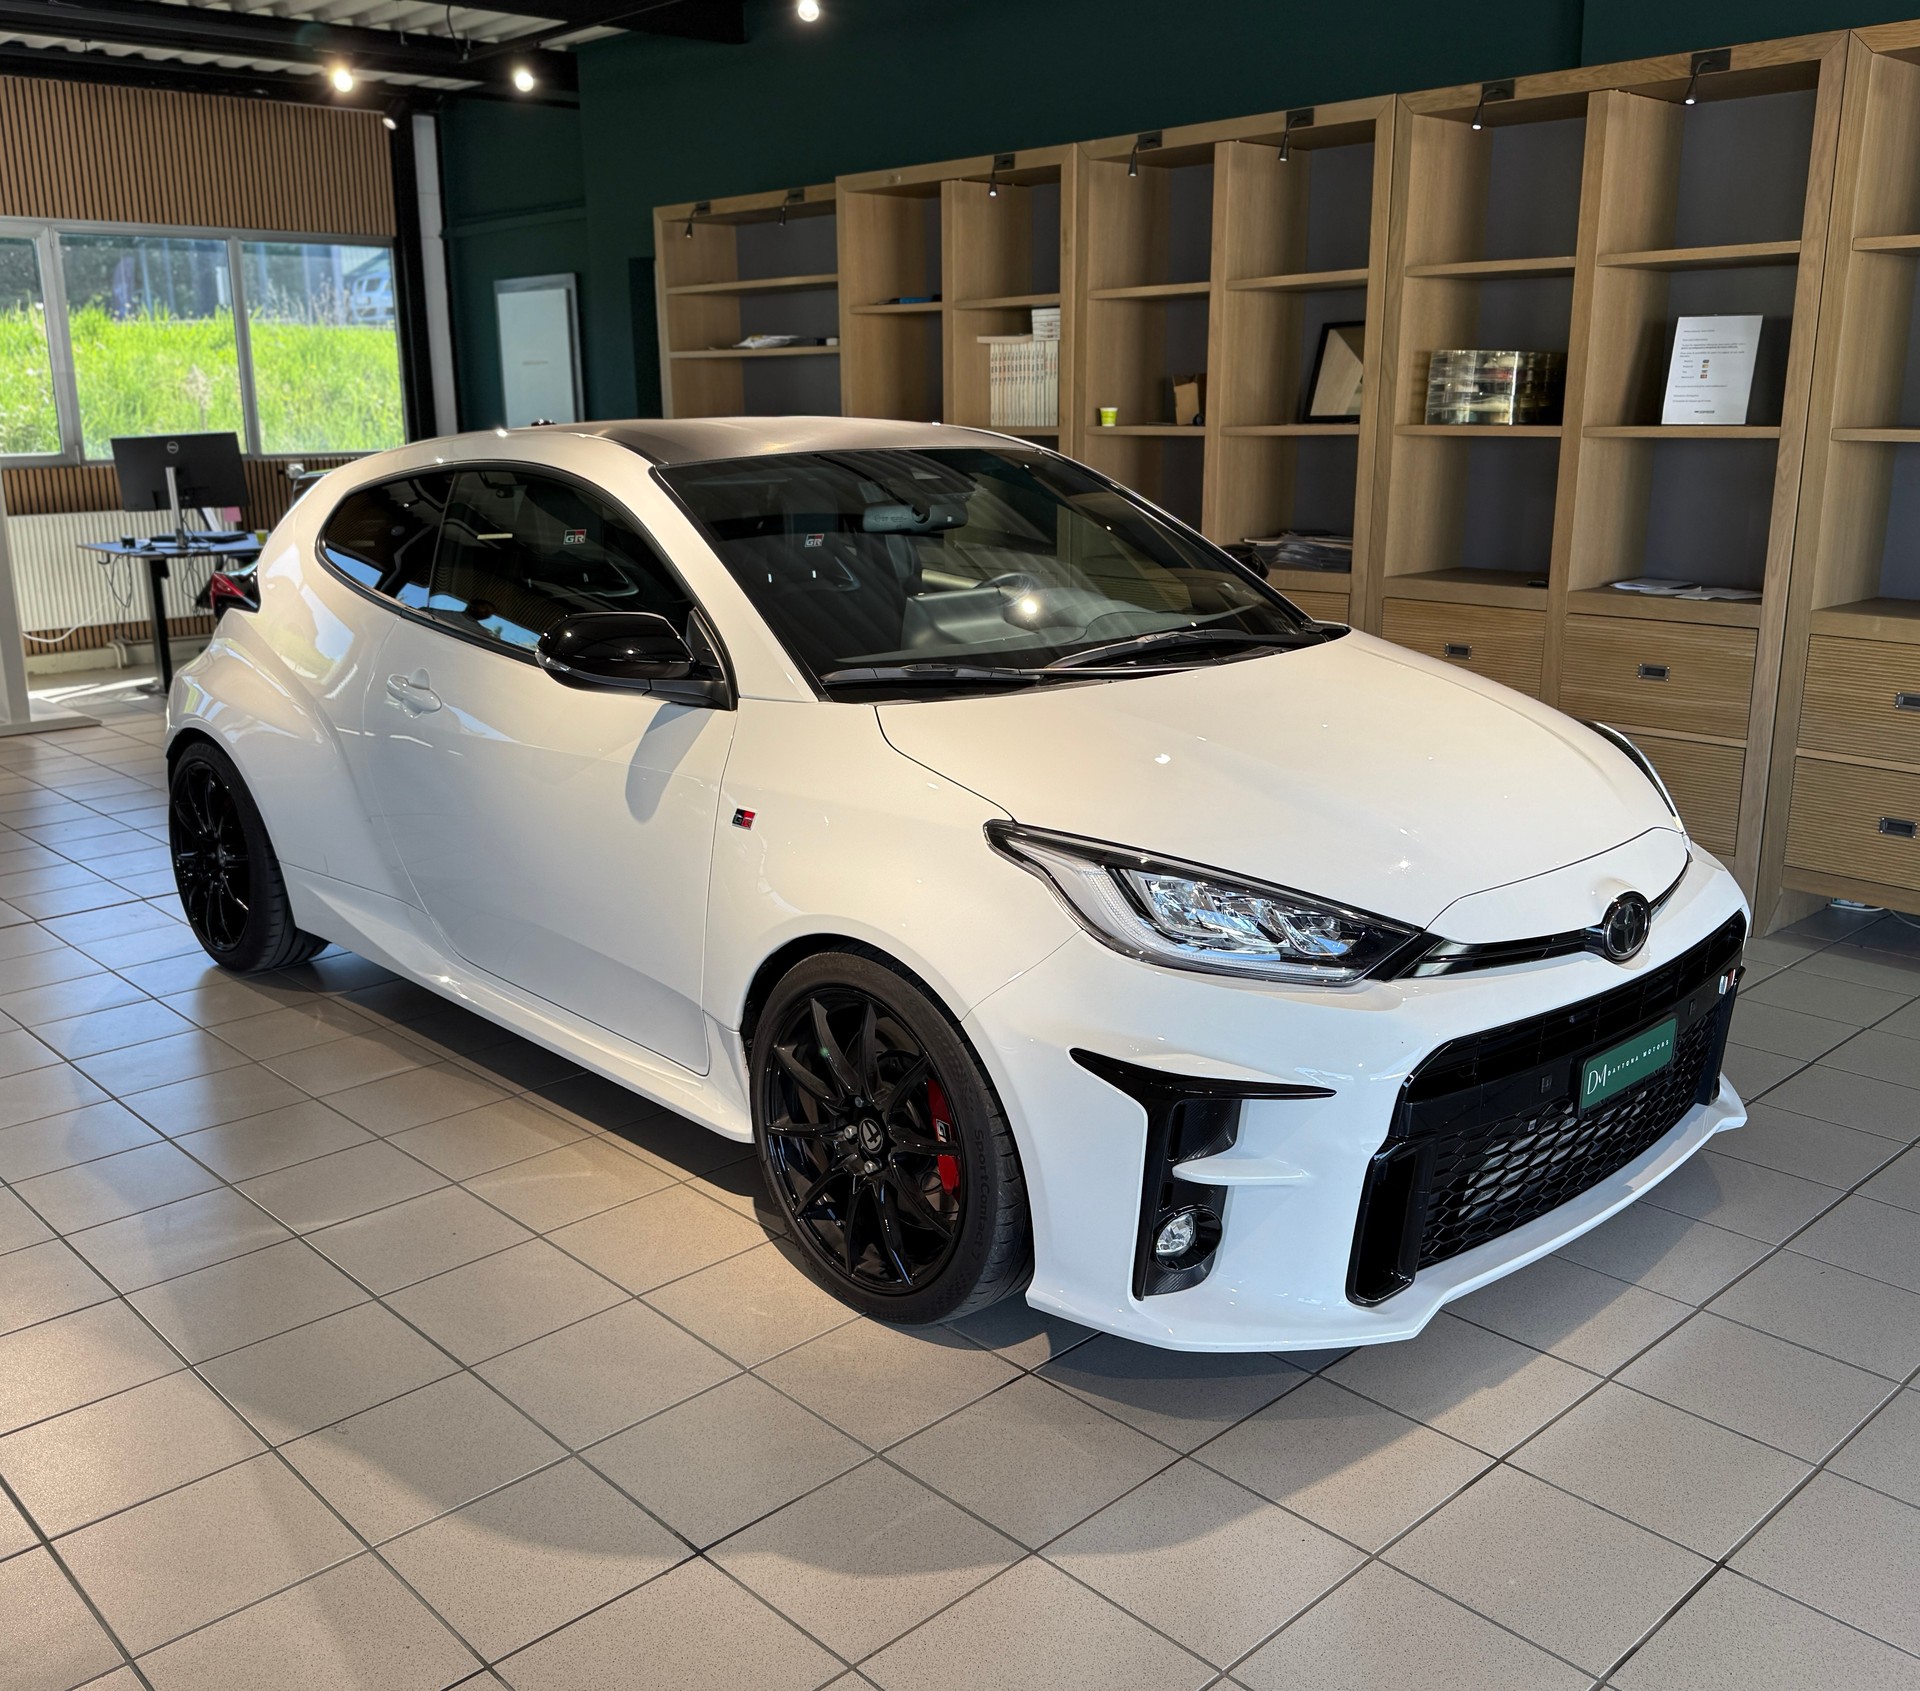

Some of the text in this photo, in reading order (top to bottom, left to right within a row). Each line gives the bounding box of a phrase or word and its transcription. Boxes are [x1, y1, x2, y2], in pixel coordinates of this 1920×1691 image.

[565, 531, 585, 544] GR
[806, 535, 823, 547] GR
[1607, 1055, 1639, 1077] DAYTONA
[1642, 1039, 1669, 1058] MOTORS
